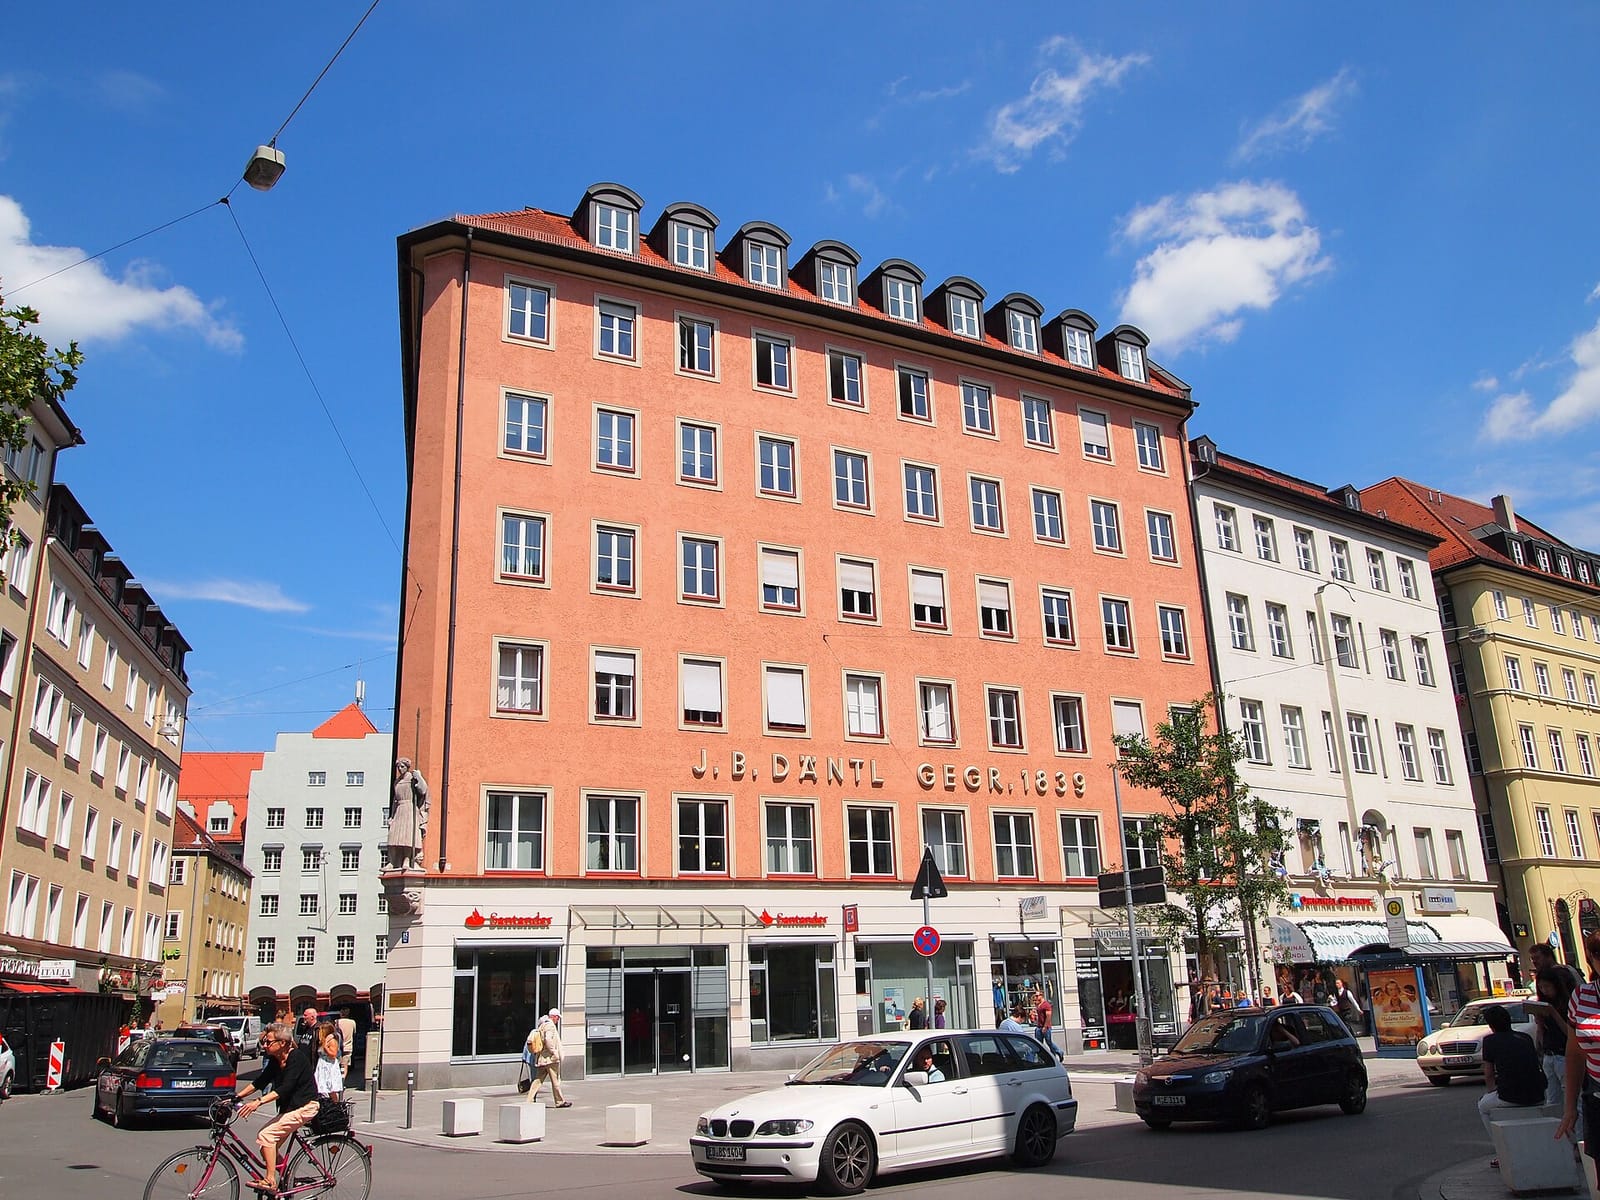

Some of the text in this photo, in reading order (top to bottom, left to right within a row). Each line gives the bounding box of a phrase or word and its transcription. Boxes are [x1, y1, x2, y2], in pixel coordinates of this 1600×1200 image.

[771, 752, 885, 787] DÄNTL
[1021, 768, 1087, 798] 1839
[490, 912, 552, 928] Santander
[777, 912, 826, 926] Santander
[41, 968, 71, 976] ITALIA
